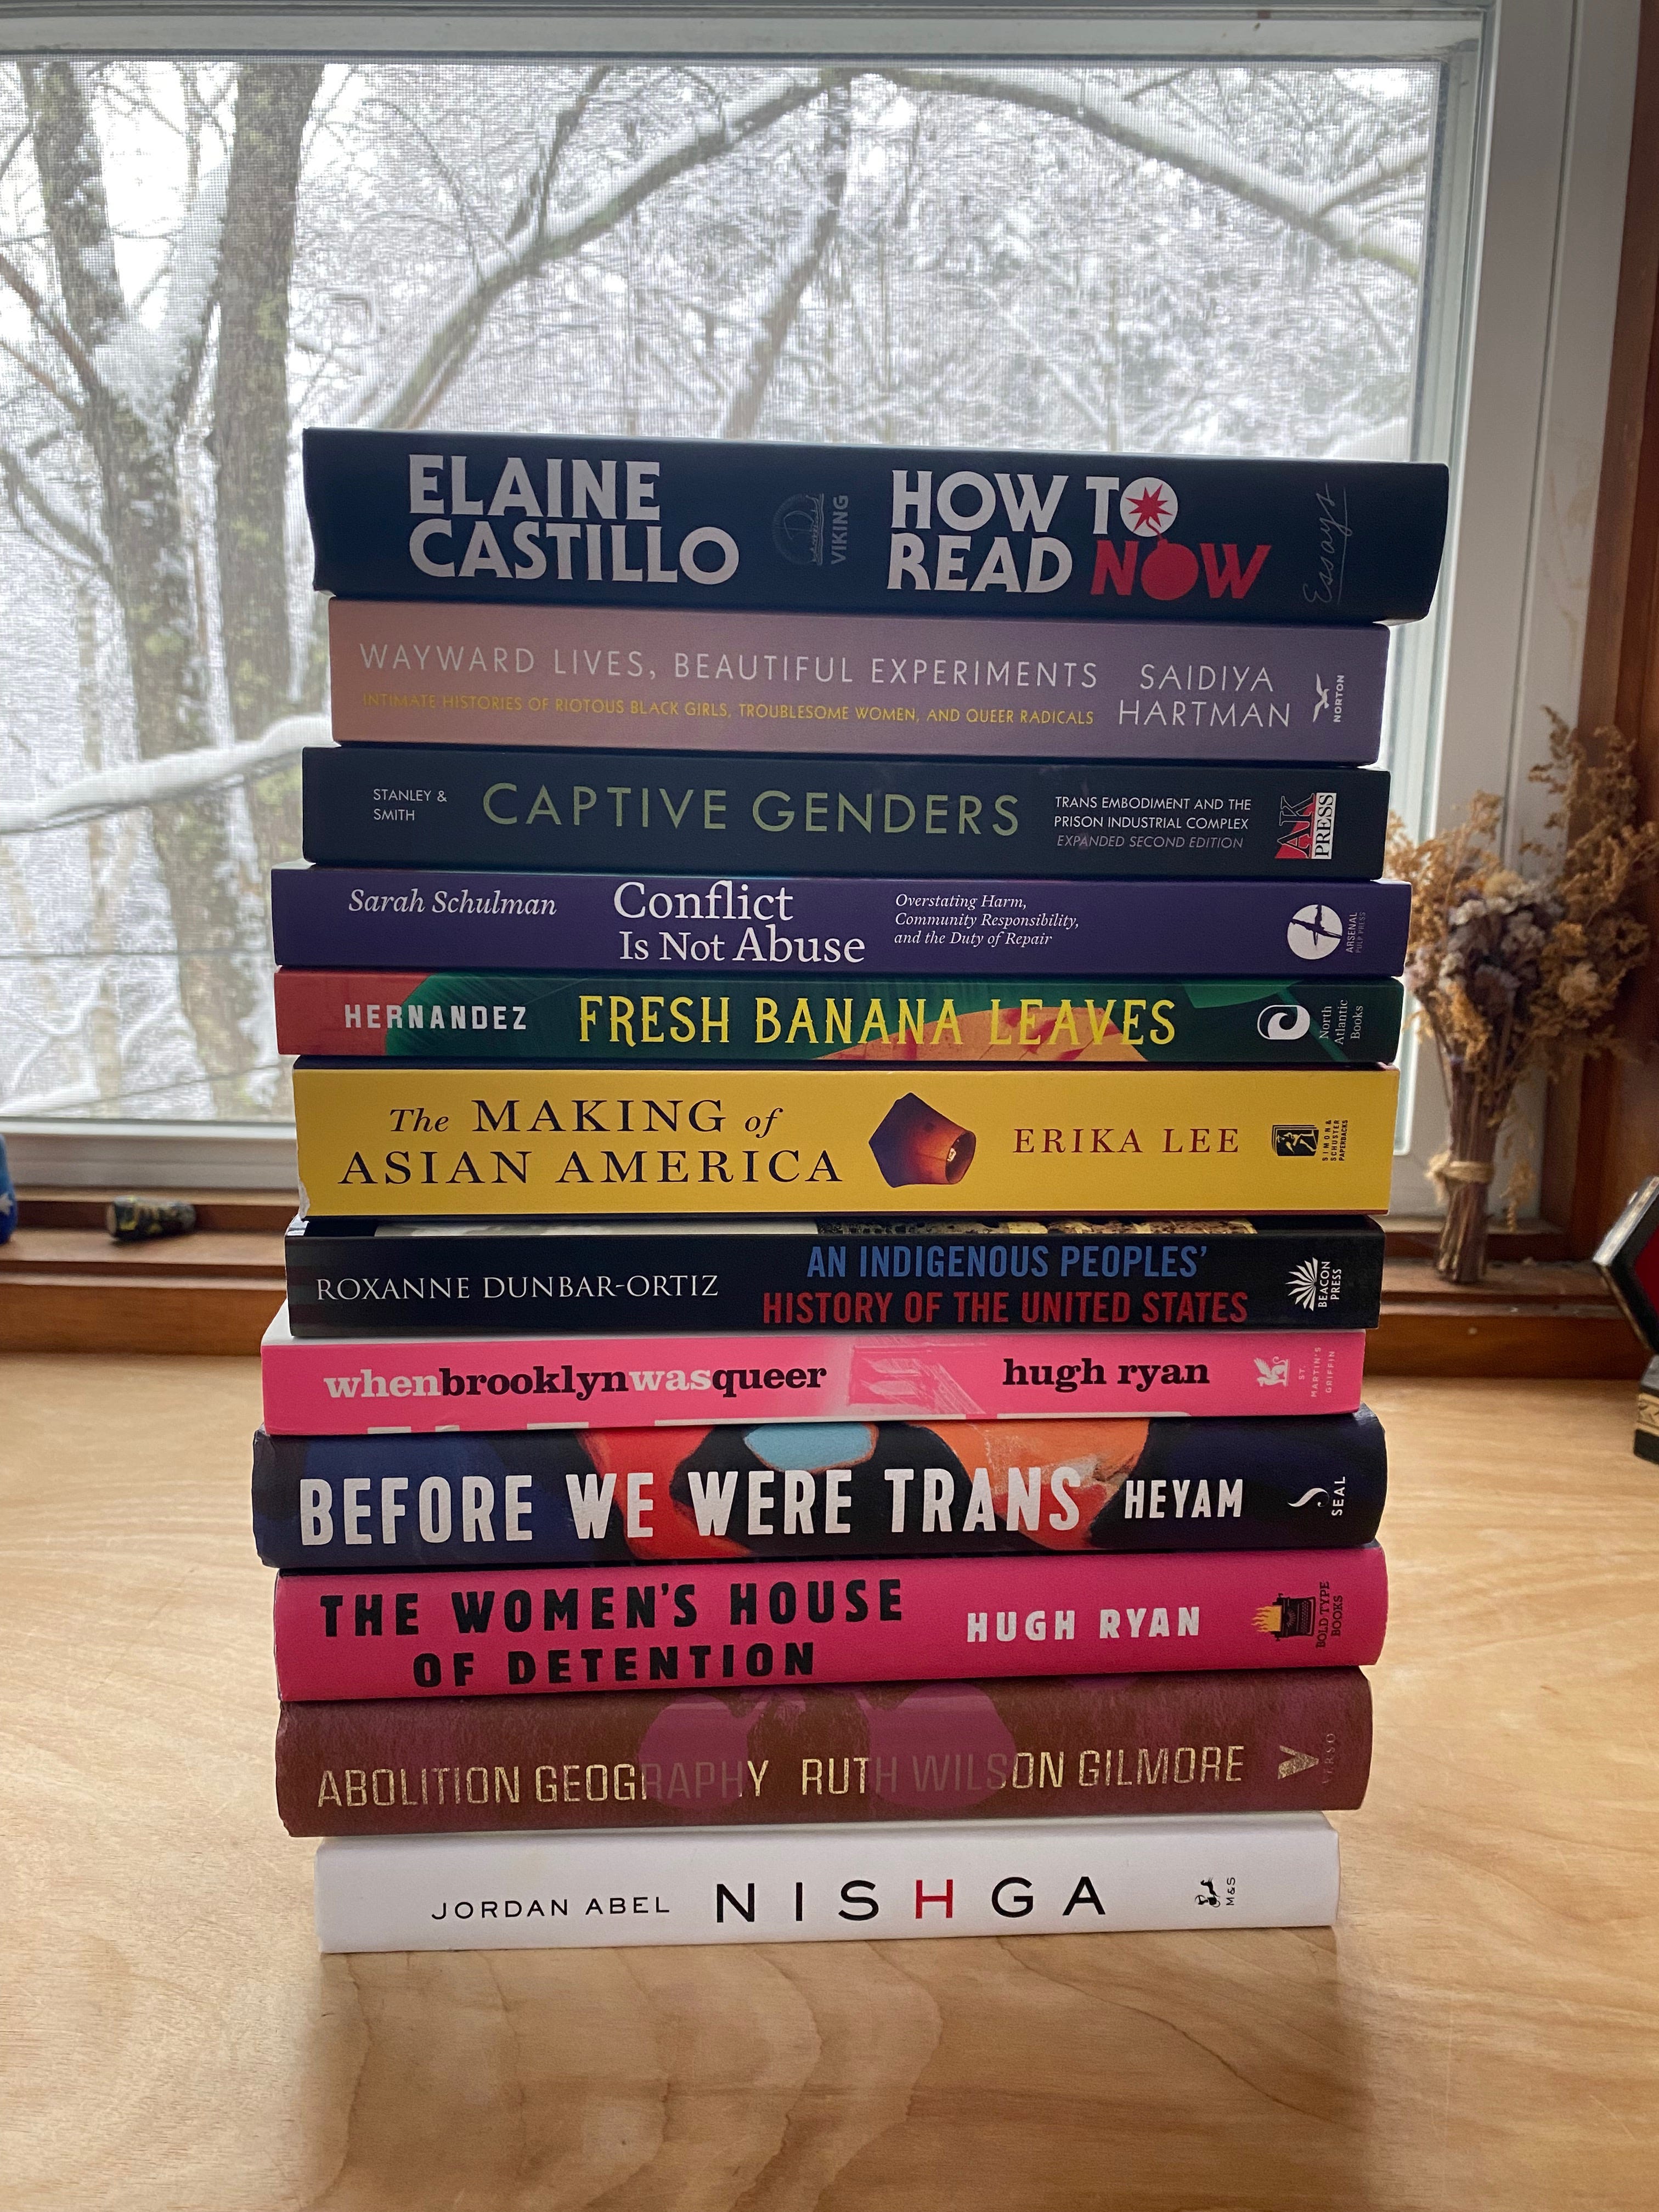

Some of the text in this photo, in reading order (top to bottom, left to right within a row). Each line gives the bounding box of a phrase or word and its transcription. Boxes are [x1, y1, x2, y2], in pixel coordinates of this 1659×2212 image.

[409, 454, 660, 522] ELAINE
[891, 470, 1178, 538] HOW TO
[831, 495, 849, 565] VIKING
[1303, 482, 1352, 603] Essays
[409, 518, 739, 585] CASTILLO
[887, 532, 1272, 601] READ NOW
[360, 644, 1096, 688] WAYWARD LIVES, BEAUTIFUL EXPERIMENTS
[1140, 664, 1273, 692] SAIDIYA
[362, 693, 1093, 725] INTIMATE HISTORIES OF RIOTOUS BLACK GIRLS, TROUBLESOME WOMEN, AND QUEER RADICALS
[1119, 699, 1290, 727] HARTMAN
[1333, 675, 1345, 723] NORTON
[373, 788, 448, 803] STANLEY &
[374, 808, 415, 821] SMITH
[483, 782, 1018, 836] CAPTIVE GENDERS
[1055, 796, 1251, 810] TRANS EMBODIMENT AND THE
[1054, 816, 1249, 830] PRISON INDUSTRIAL COMPLEX
[1057, 835, 1243, 849] EXPANDED SECOND EDITION
[1277, 793, 1316, 859] AK
[1314, 794, 1334, 857] PRESS
[348, 888, 557, 915] Sarah Schulman
[614, 879, 793, 921] Conflict
[895, 894, 1026, 911] Overstating Harm,
[894, 930, 1052, 948] and the Duty of Repair
[895, 910, 1079, 932] Community Responsibility,
[1345, 912, 1358, 953] ARSENAL
[619, 923, 865, 963] Is Not Abuse
[1355, 936, 1364, 953] PULP
[345, 1005, 528, 1030] HERNANDEZ
[579, 995, 1176, 1047] FRESH BANANA LEAVES
[1319, 1006, 1332, 1040] North
[1334, 1000, 1348, 1045] Atlantic
[1350, 1005, 1364, 1040] Books
[390, 1099, 783, 1138] The MAKING of
[1014, 1128, 1238, 1153] ERIKA LEE
[1322, 1127, 1331, 1161] SIMON
[1331, 1120, 1340, 1161] SCHUSTER
[1339, 1120, 1348, 1161] PAPERBACKS
[338, 1150, 843, 1184] ASIAN AMERICA
[806, 1246, 846, 1277] AN
[860, 1245, 1049, 1278] INDIGENOUS
[317, 1275, 718, 1300] ROXANNE DUNBAR-ORTIZ
[1318, 1261, 1330, 1308] BEACON
[1330, 1268, 1342, 1300] PRESS
[763, 1291, 1248, 1324] HISTORY OF THE UNITED STATES
[1002, 1357, 1210, 1393] hugh ryan
[1325, 1351, 1335, 1393] GRIFFIN
[300, 1466, 1081, 1545] BEFORE WE WERE TRANS
[1122, 1477, 1243, 1519] HEYAM
[1331, 1477, 1345, 1516] SEAL
[320, 1593, 419, 1637] THE
[730, 1579, 902, 1626] HOUSE
[967, 1606, 1200, 1643] HUGH RYAN
[1316, 1581, 1330, 1649] BOLD TYPE
[1331, 1595, 1344, 1637] BOOKS
[413, 1642, 816, 1688] OF DETENTION
[318, 1759, 769, 1807] ABOLITION GEOGRAPHY
[802, 1746, 1244, 1795] RUTH WILSON GILMORE
[431, 1897, 670, 1920] JORDAN ABEL
[1226, 1877, 1235, 1905] M&S
